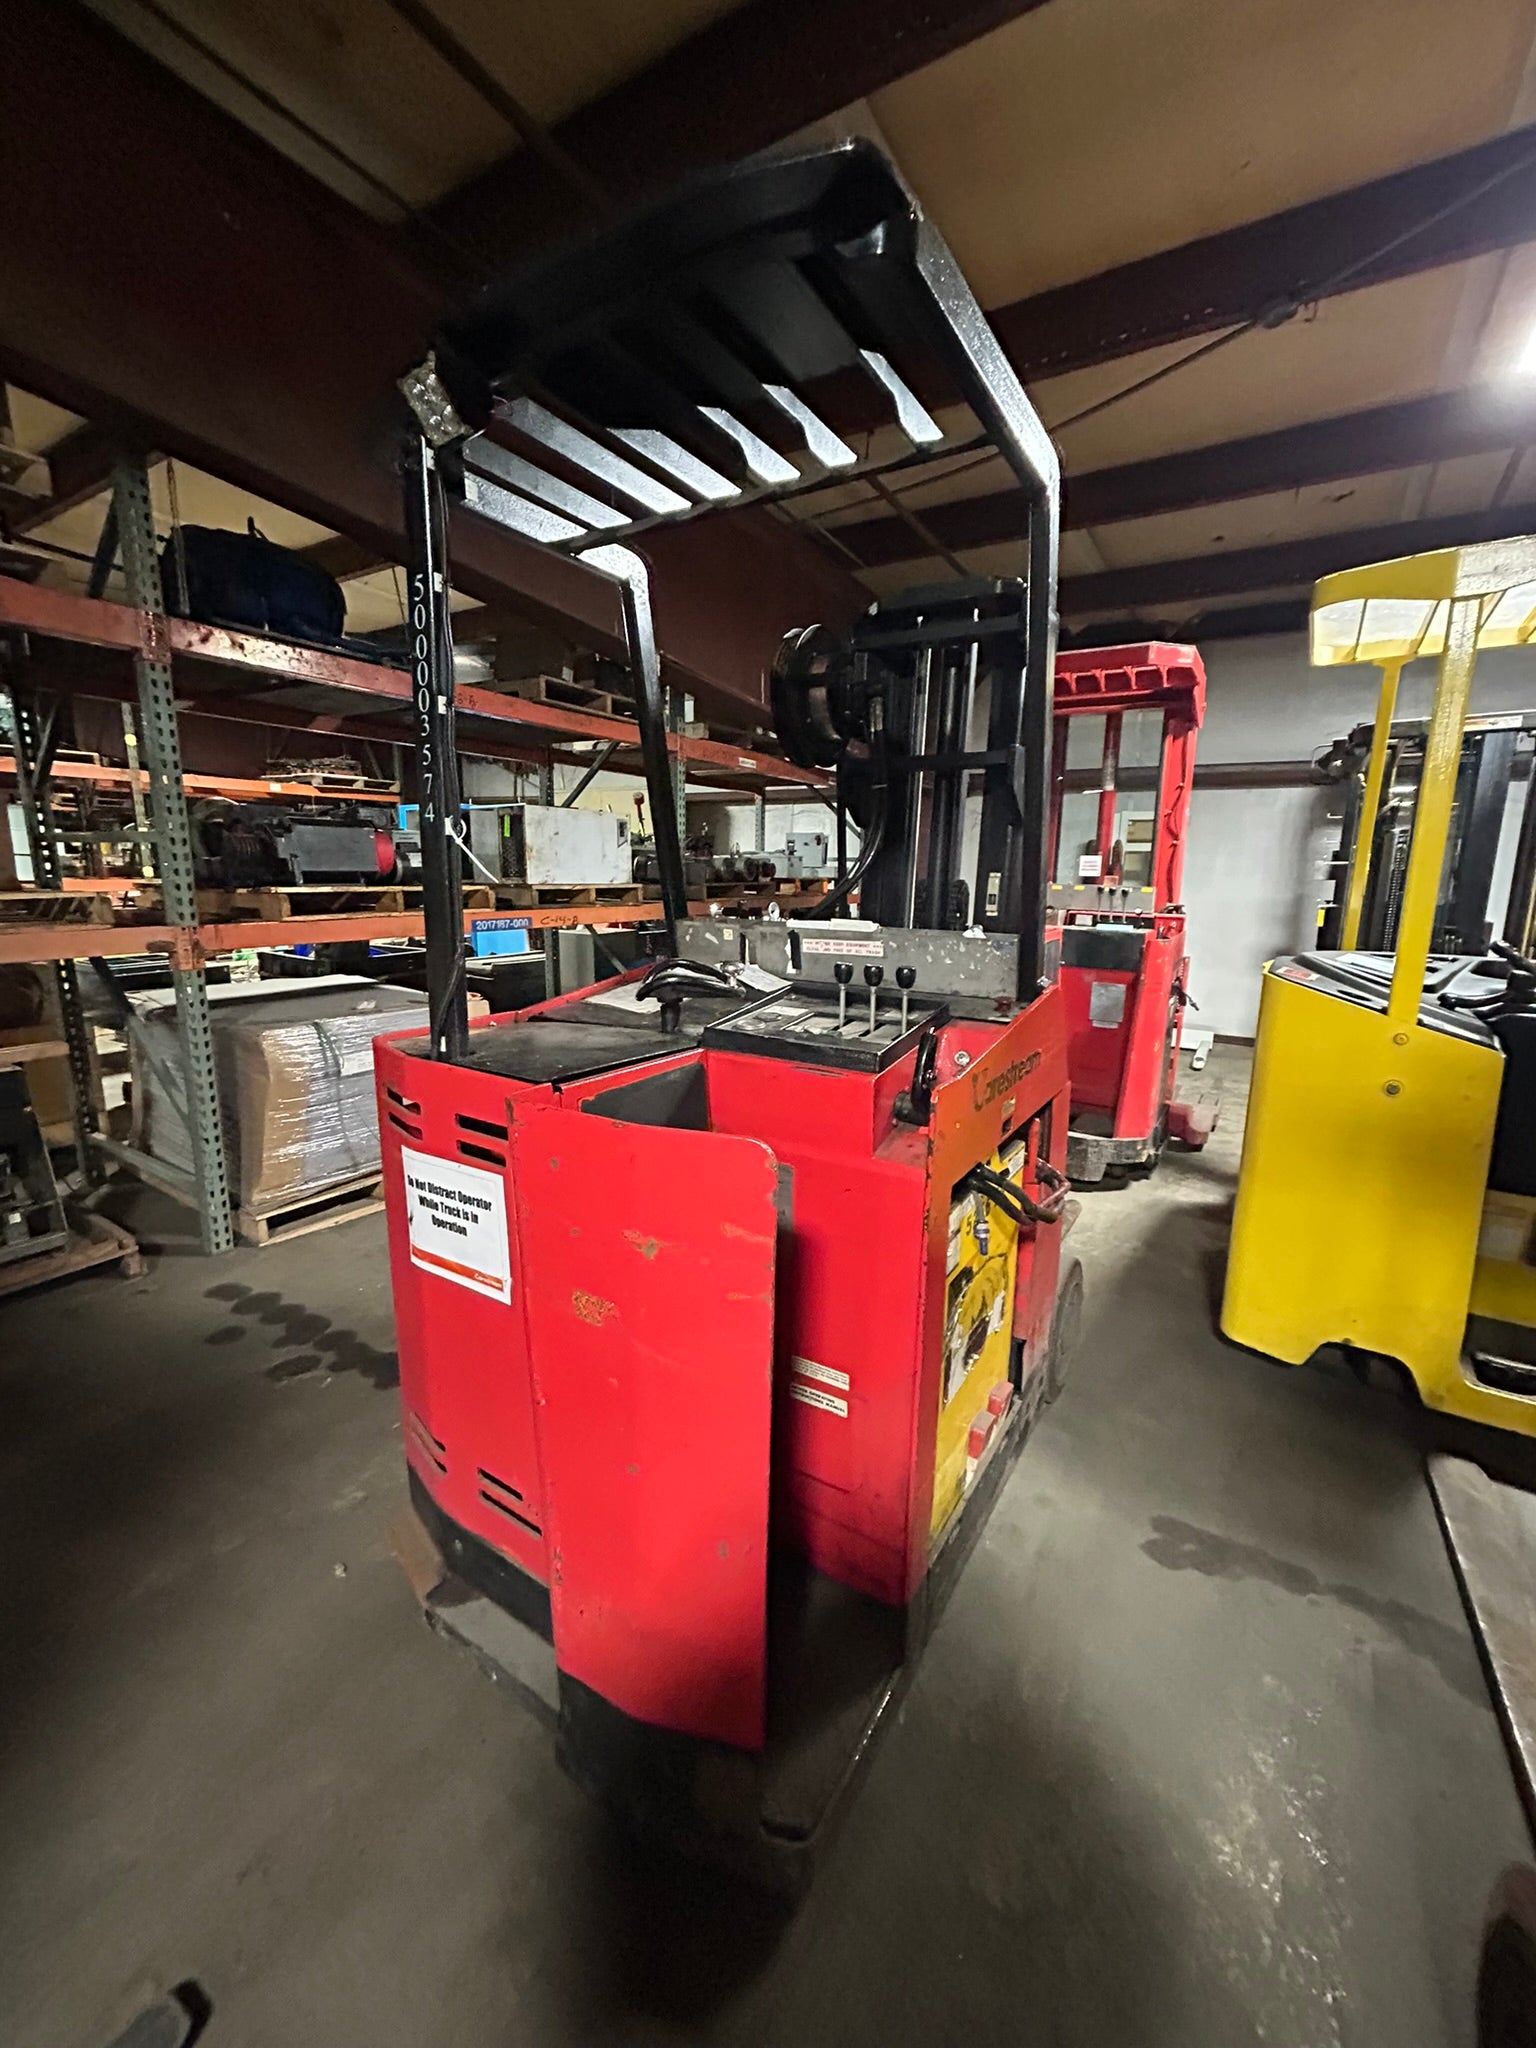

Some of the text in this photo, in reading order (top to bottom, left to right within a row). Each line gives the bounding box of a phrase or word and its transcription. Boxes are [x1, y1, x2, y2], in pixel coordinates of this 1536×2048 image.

[413, 574, 435, 823] 500003574
[415, 1178, 427, 1192] Not
[427, 1182, 456, 1201] Distract
[457, 1190, 492, 1212] Operator
[418, 1194, 439, 1211] While
[440, 1201, 461, 1219] Truck
[431, 1214, 468, 1237] Operation
